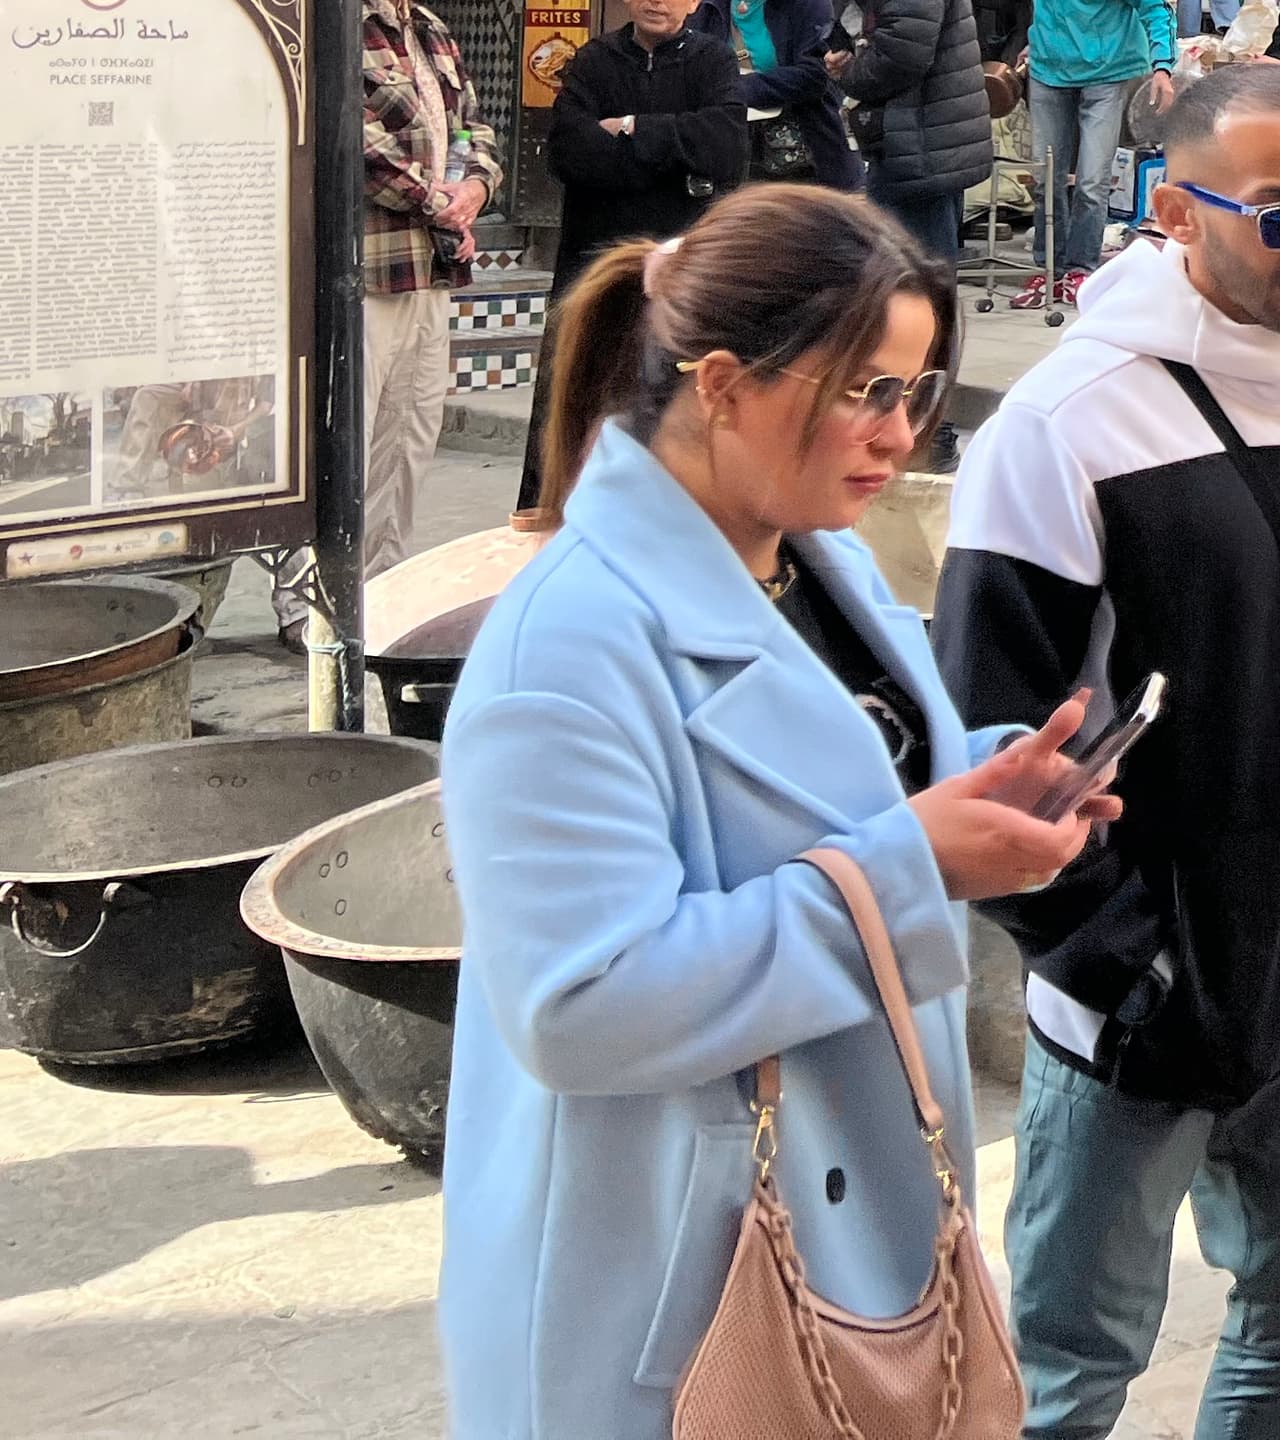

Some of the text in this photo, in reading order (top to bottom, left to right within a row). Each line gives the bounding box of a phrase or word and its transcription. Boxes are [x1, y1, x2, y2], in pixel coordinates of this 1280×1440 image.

[531, 12, 582, 24] FRITES
[11, 17, 190, 49] ساحة الصفارين
[49, 74, 153, 85] PLACE SEFFARINE
